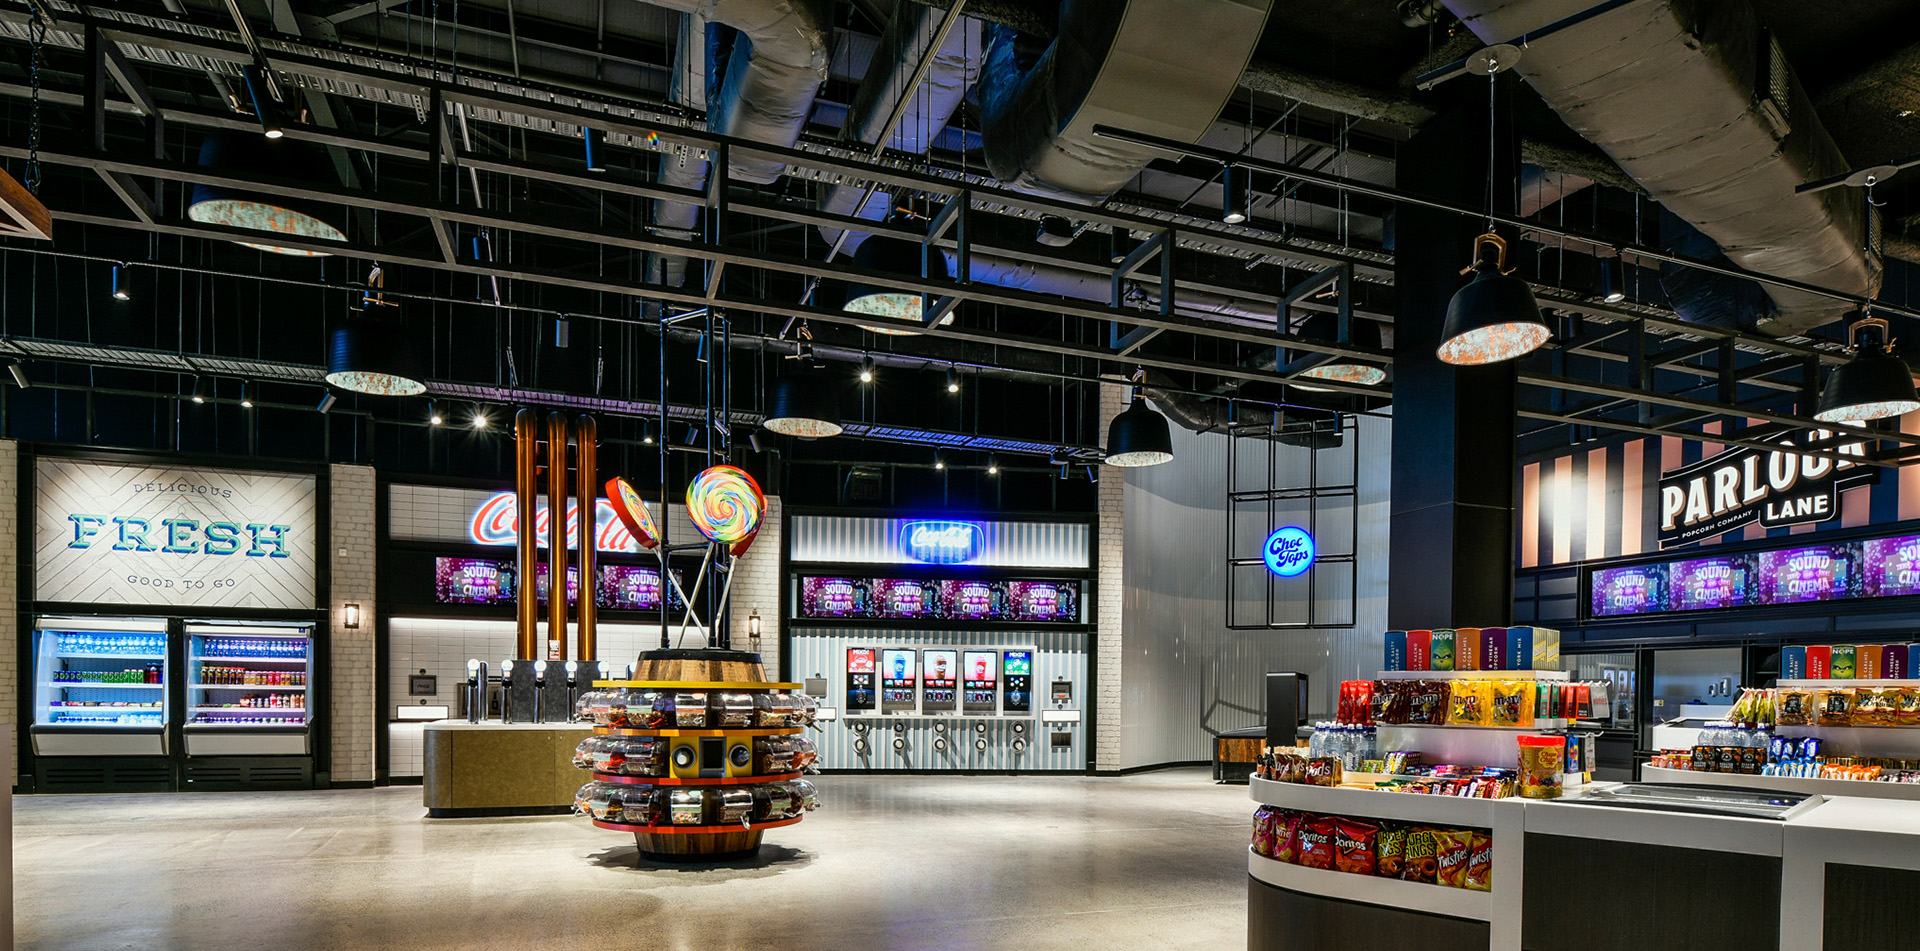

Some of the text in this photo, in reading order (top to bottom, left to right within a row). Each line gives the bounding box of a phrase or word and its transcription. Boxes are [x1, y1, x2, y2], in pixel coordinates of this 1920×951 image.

[133, 482, 233, 499] DELICIOUS
[1766, 494, 1829, 521] LANE
[473, 494, 633, 550] Coala
[1681, 509, 1753, 539] POPCORN COMPANY
[67, 513, 292, 558] FRESH
[1269, 537, 1304, 555] Choc
[1275, 547, 1309, 568] Tops
[1788, 555, 1831, 572] SOUND
[463, 566, 498, 579] SOUND
[628, 573, 660, 586] SOUND
[1695, 565, 1731, 581] SOUND
[127, 574, 236, 590] GOOD TO GO
[1614, 574, 1646, 589] SOUND
[1788, 577, 1831, 593] CINEMA
[463, 584, 498, 597] CINEMA
[628, 591, 660, 602] CINEMA
[824, 584, 853, 595] SOUND
[893, 585, 922, 596] SOUND
[962, 587, 990, 598] SOUND
[1029, 588, 1057, 599] SOUND
[1694, 585, 1731, 600] CINEMA
[824, 600, 853, 610] CINEMA
[893, 602, 922, 612] CINEMA
[1614, 593, 1646, 607] CINEMA
[962, 603, 990, 613] CINEMA
[1029, 604, 1057, 614] CINEMA
[1432, 633, 1454, 641] NOPE
[1299, 830, 1329, 844] Doritos
[1377, 829, 1406, 847] URGER
[1406, 831, 1437, 847] URGE
[1437, 849, 1468, 870] Twisties
[1470, 847, 1492, 868] Twisti
